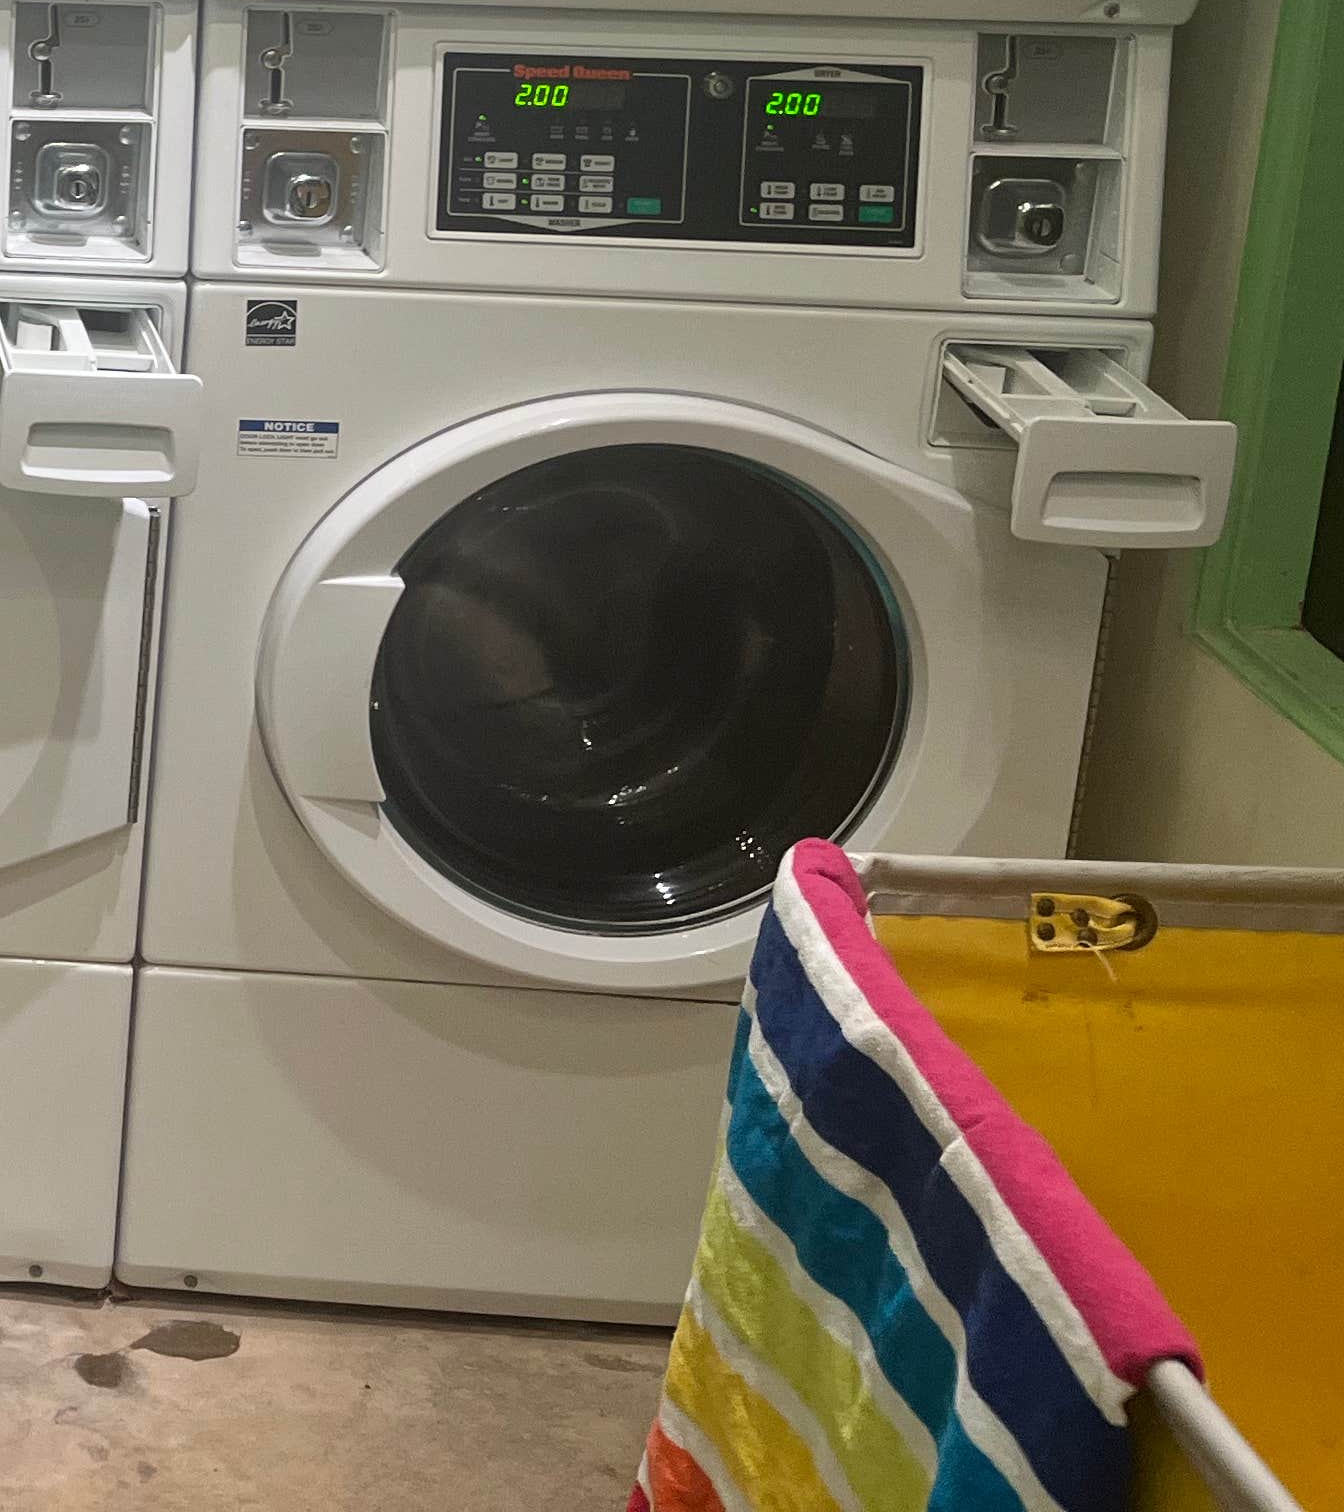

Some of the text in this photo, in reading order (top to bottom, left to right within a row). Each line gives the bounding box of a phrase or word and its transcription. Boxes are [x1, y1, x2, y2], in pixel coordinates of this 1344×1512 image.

[513, 64, 632, 81] Speed Queen
[514, 84, 569, 108] 2.00
[766, 93, 820, 116] 2.00
[264, 422, 315, 432] NOTICE
